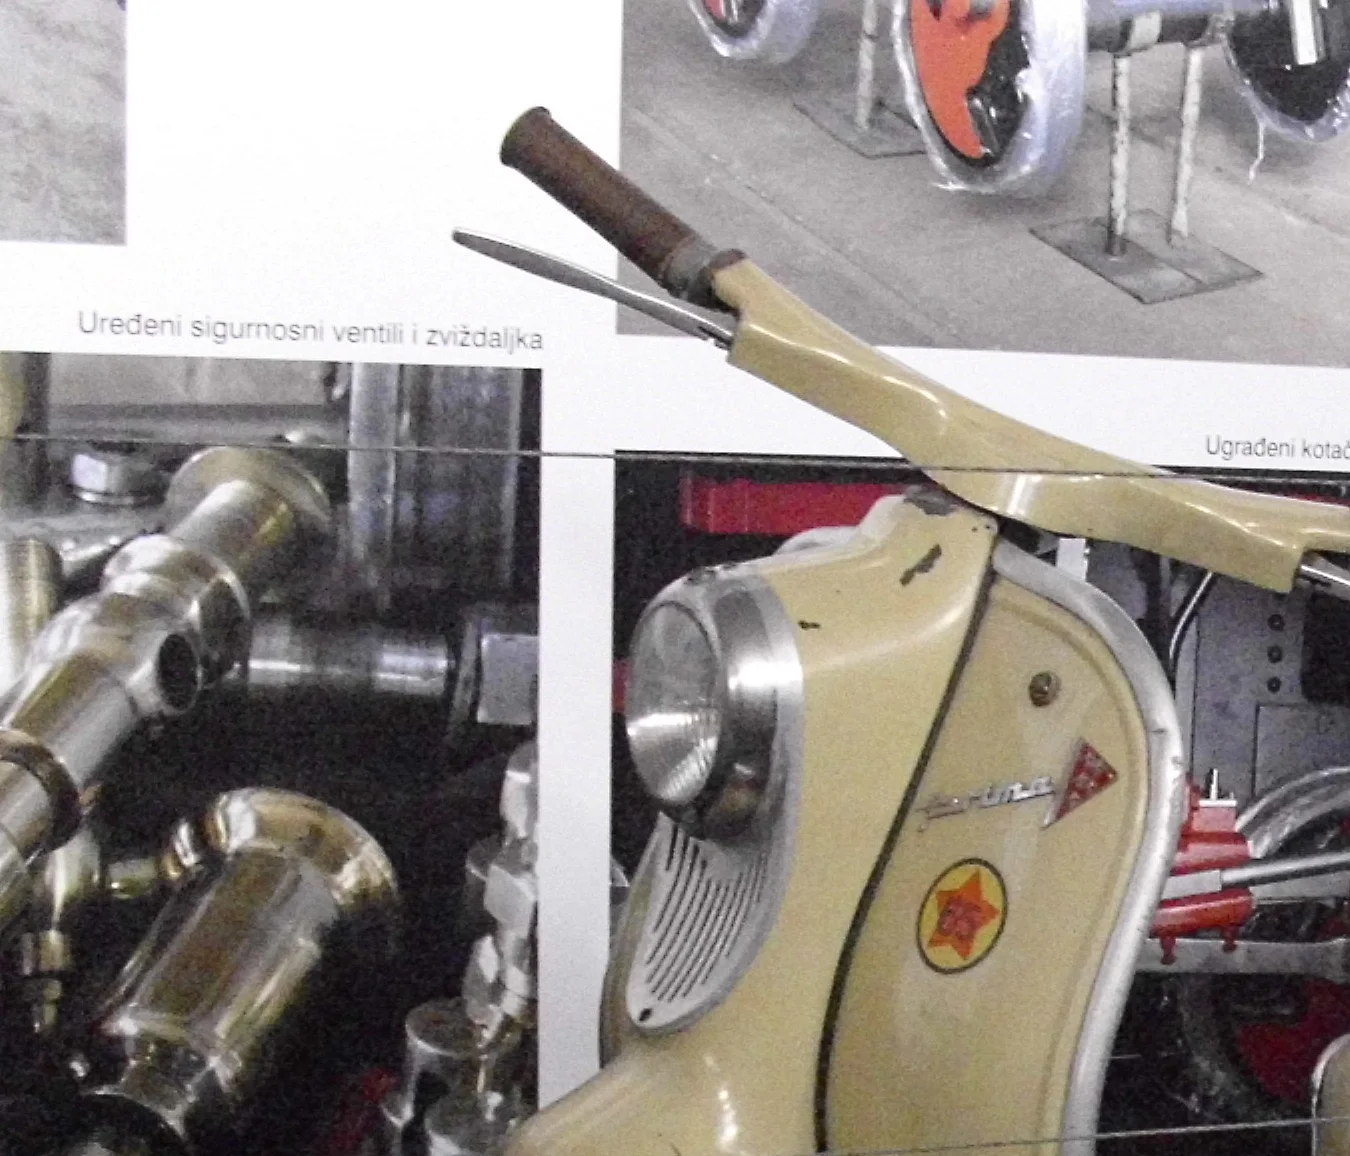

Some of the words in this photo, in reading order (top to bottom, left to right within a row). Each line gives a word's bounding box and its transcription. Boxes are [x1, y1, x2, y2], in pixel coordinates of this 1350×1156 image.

[78, 310, 182, 337] Uređeni
[191, 315, 324, 344] sigurnosni
[333, 319, 403, 343] ventili
[411, 322, 418, 345] i
[426, 323, 543, 354] zviždaljka
[1206, 435, 1295, 460] Ugrađeni
